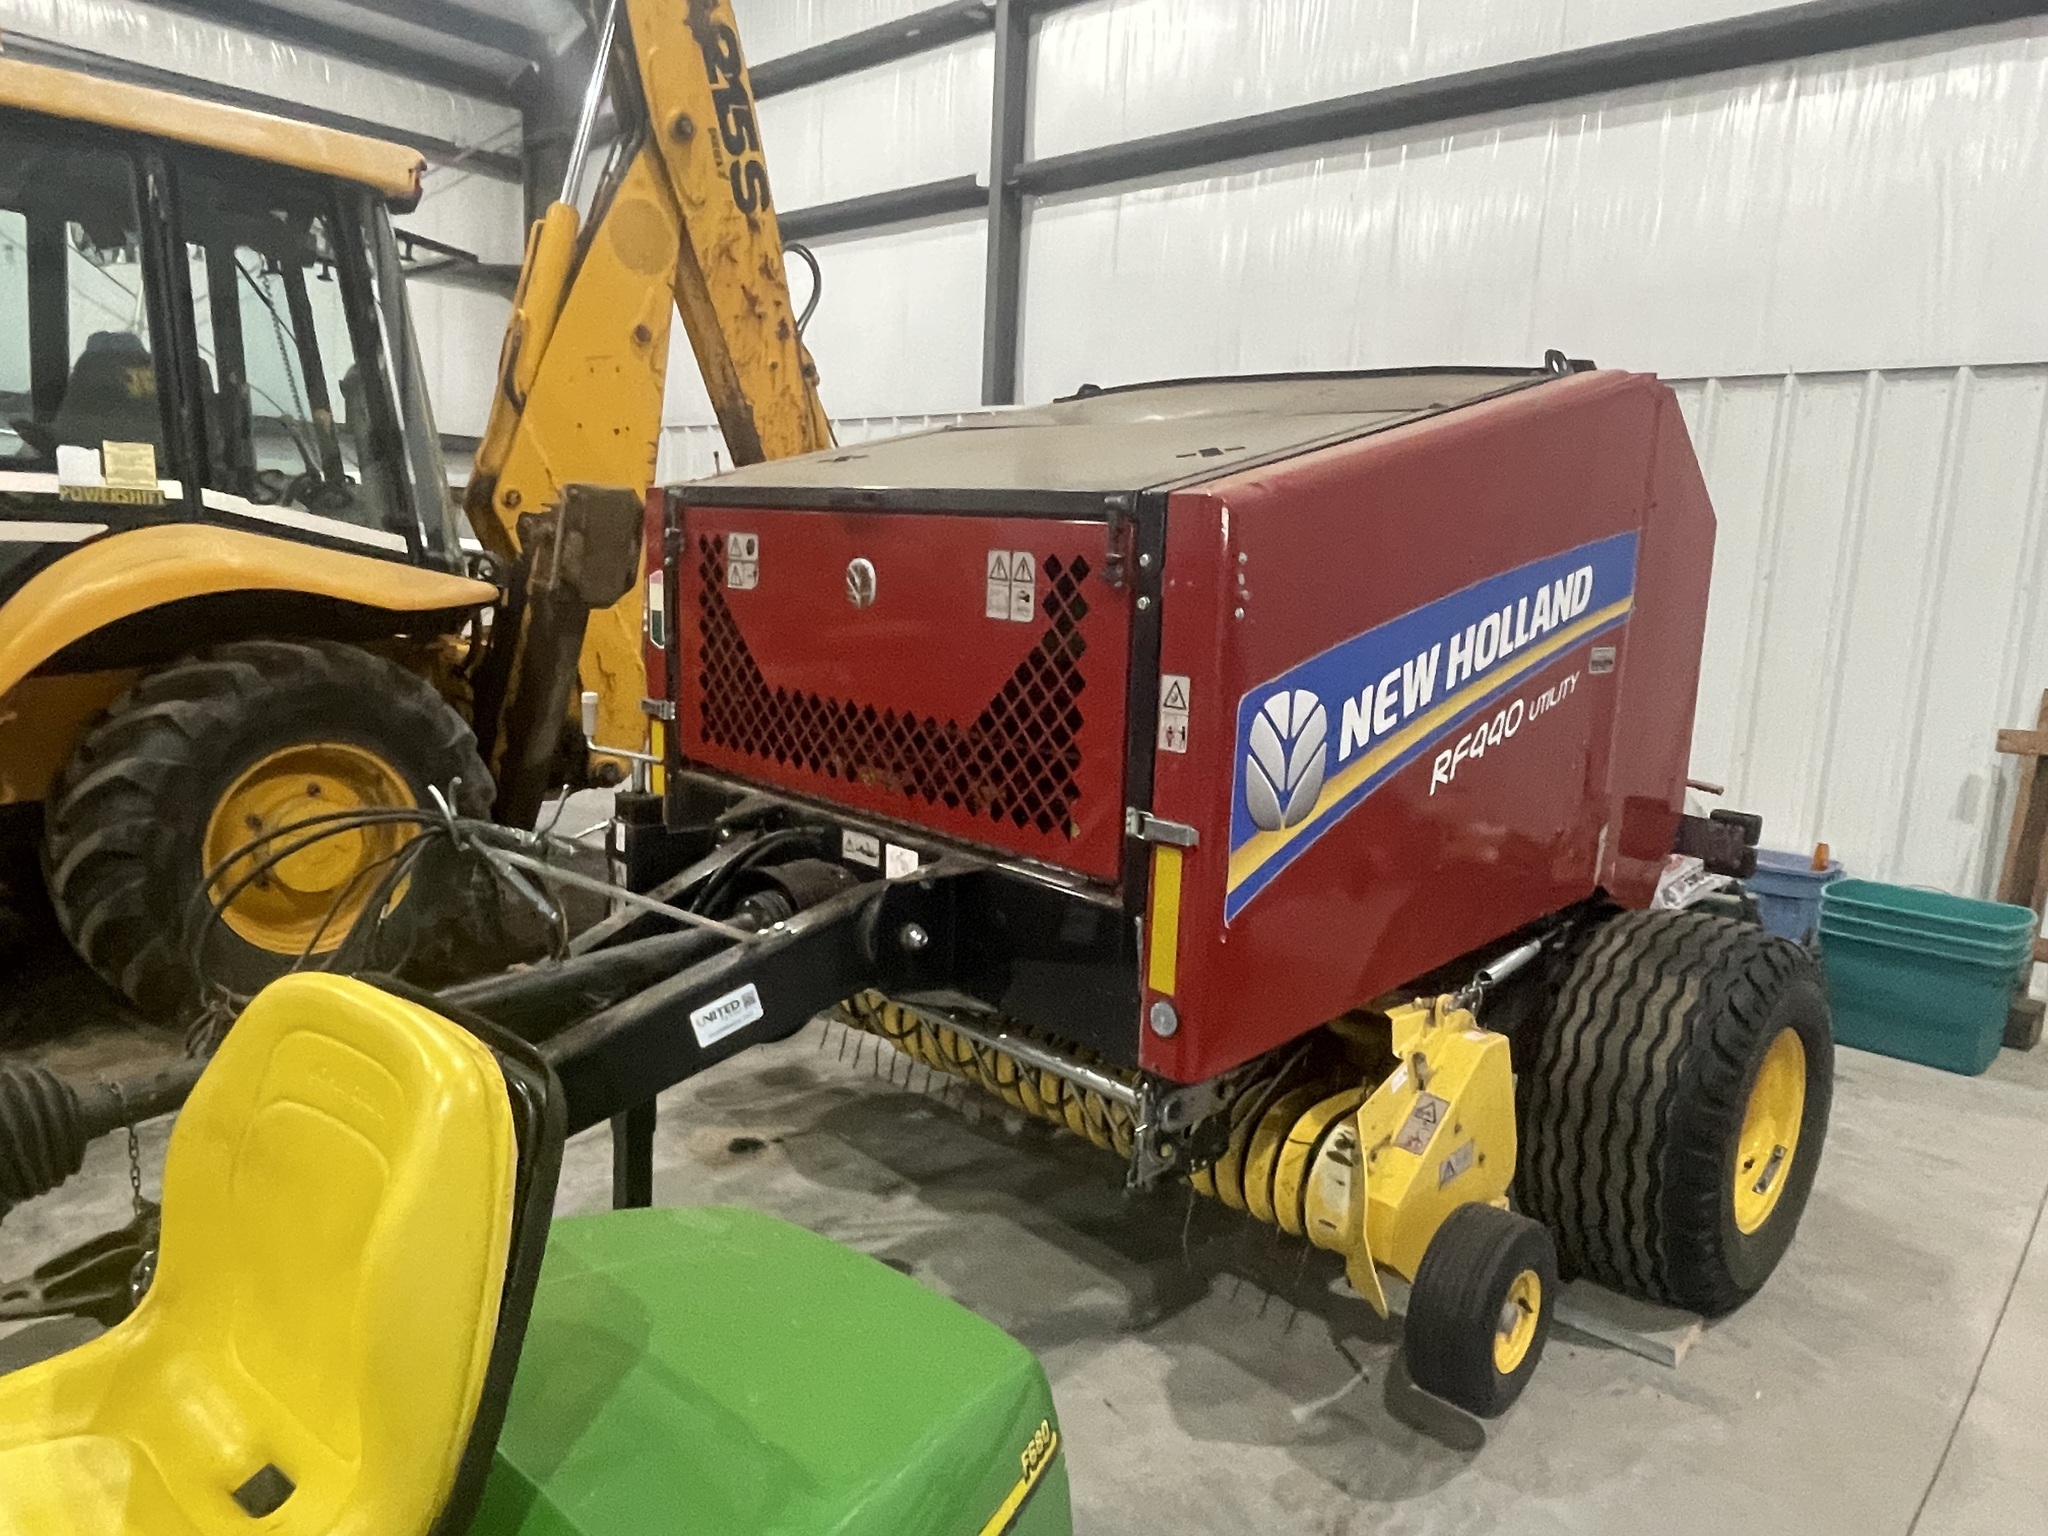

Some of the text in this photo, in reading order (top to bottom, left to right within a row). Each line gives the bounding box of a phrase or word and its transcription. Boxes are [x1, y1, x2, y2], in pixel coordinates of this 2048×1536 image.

[60, 486, 166, 506] POWERSHIFT
[1338, 564, 1594, 762] NEW HOLLAND
[1428, 670, 1581, 796] RF440 UTILITY
[696, 999, 741, 1028] UNITED
